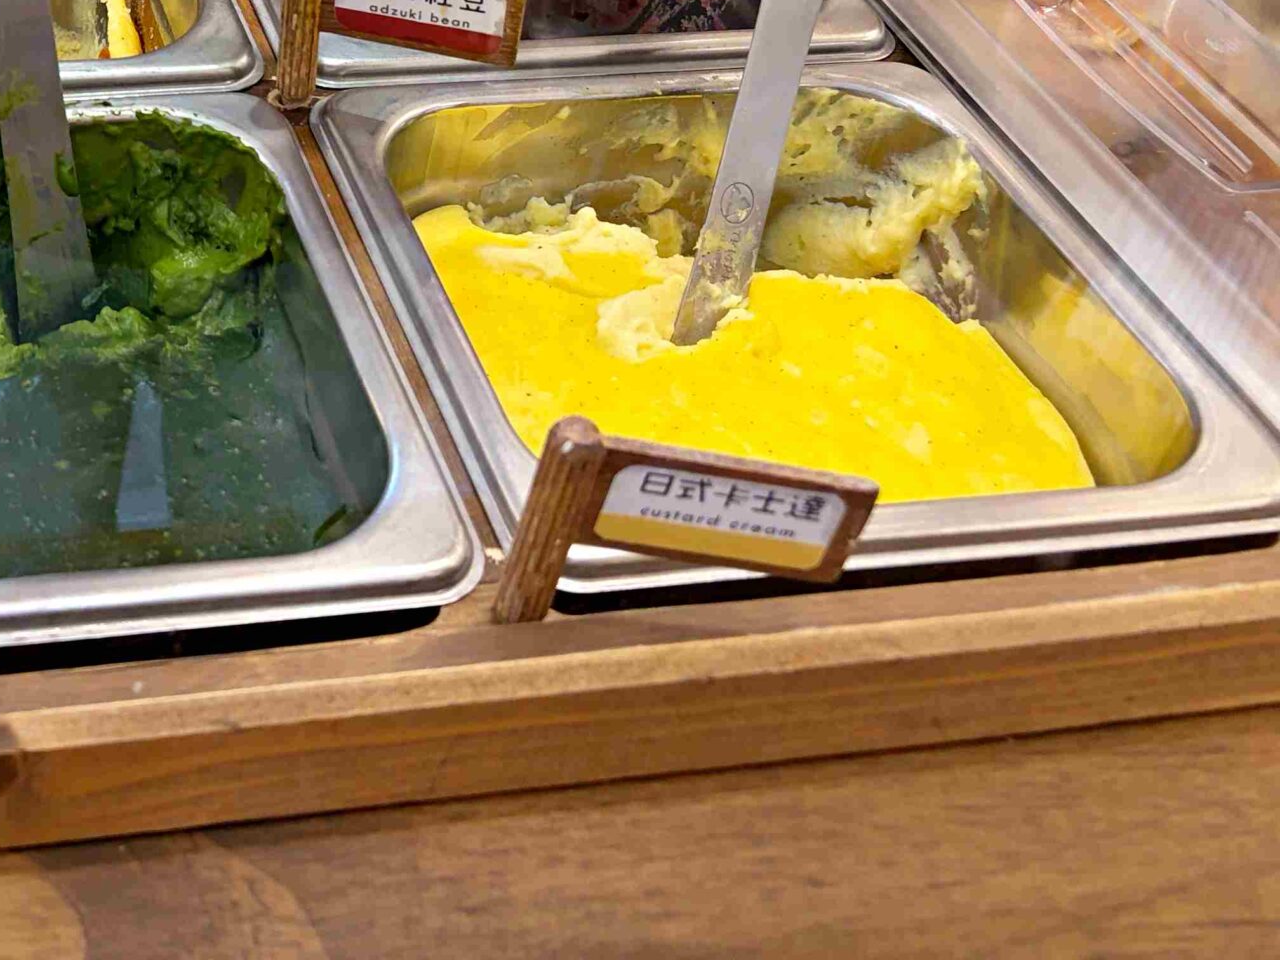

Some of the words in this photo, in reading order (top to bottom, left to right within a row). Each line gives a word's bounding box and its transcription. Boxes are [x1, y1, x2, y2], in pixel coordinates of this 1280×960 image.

[369, 4, 423, 21] adzuki
[430, 13, 471, 29] bean
[639, 471, 827, 522] 日式卡士達
[640, 506, 721, 527] custard
[729, 520, 796, 538] cream
